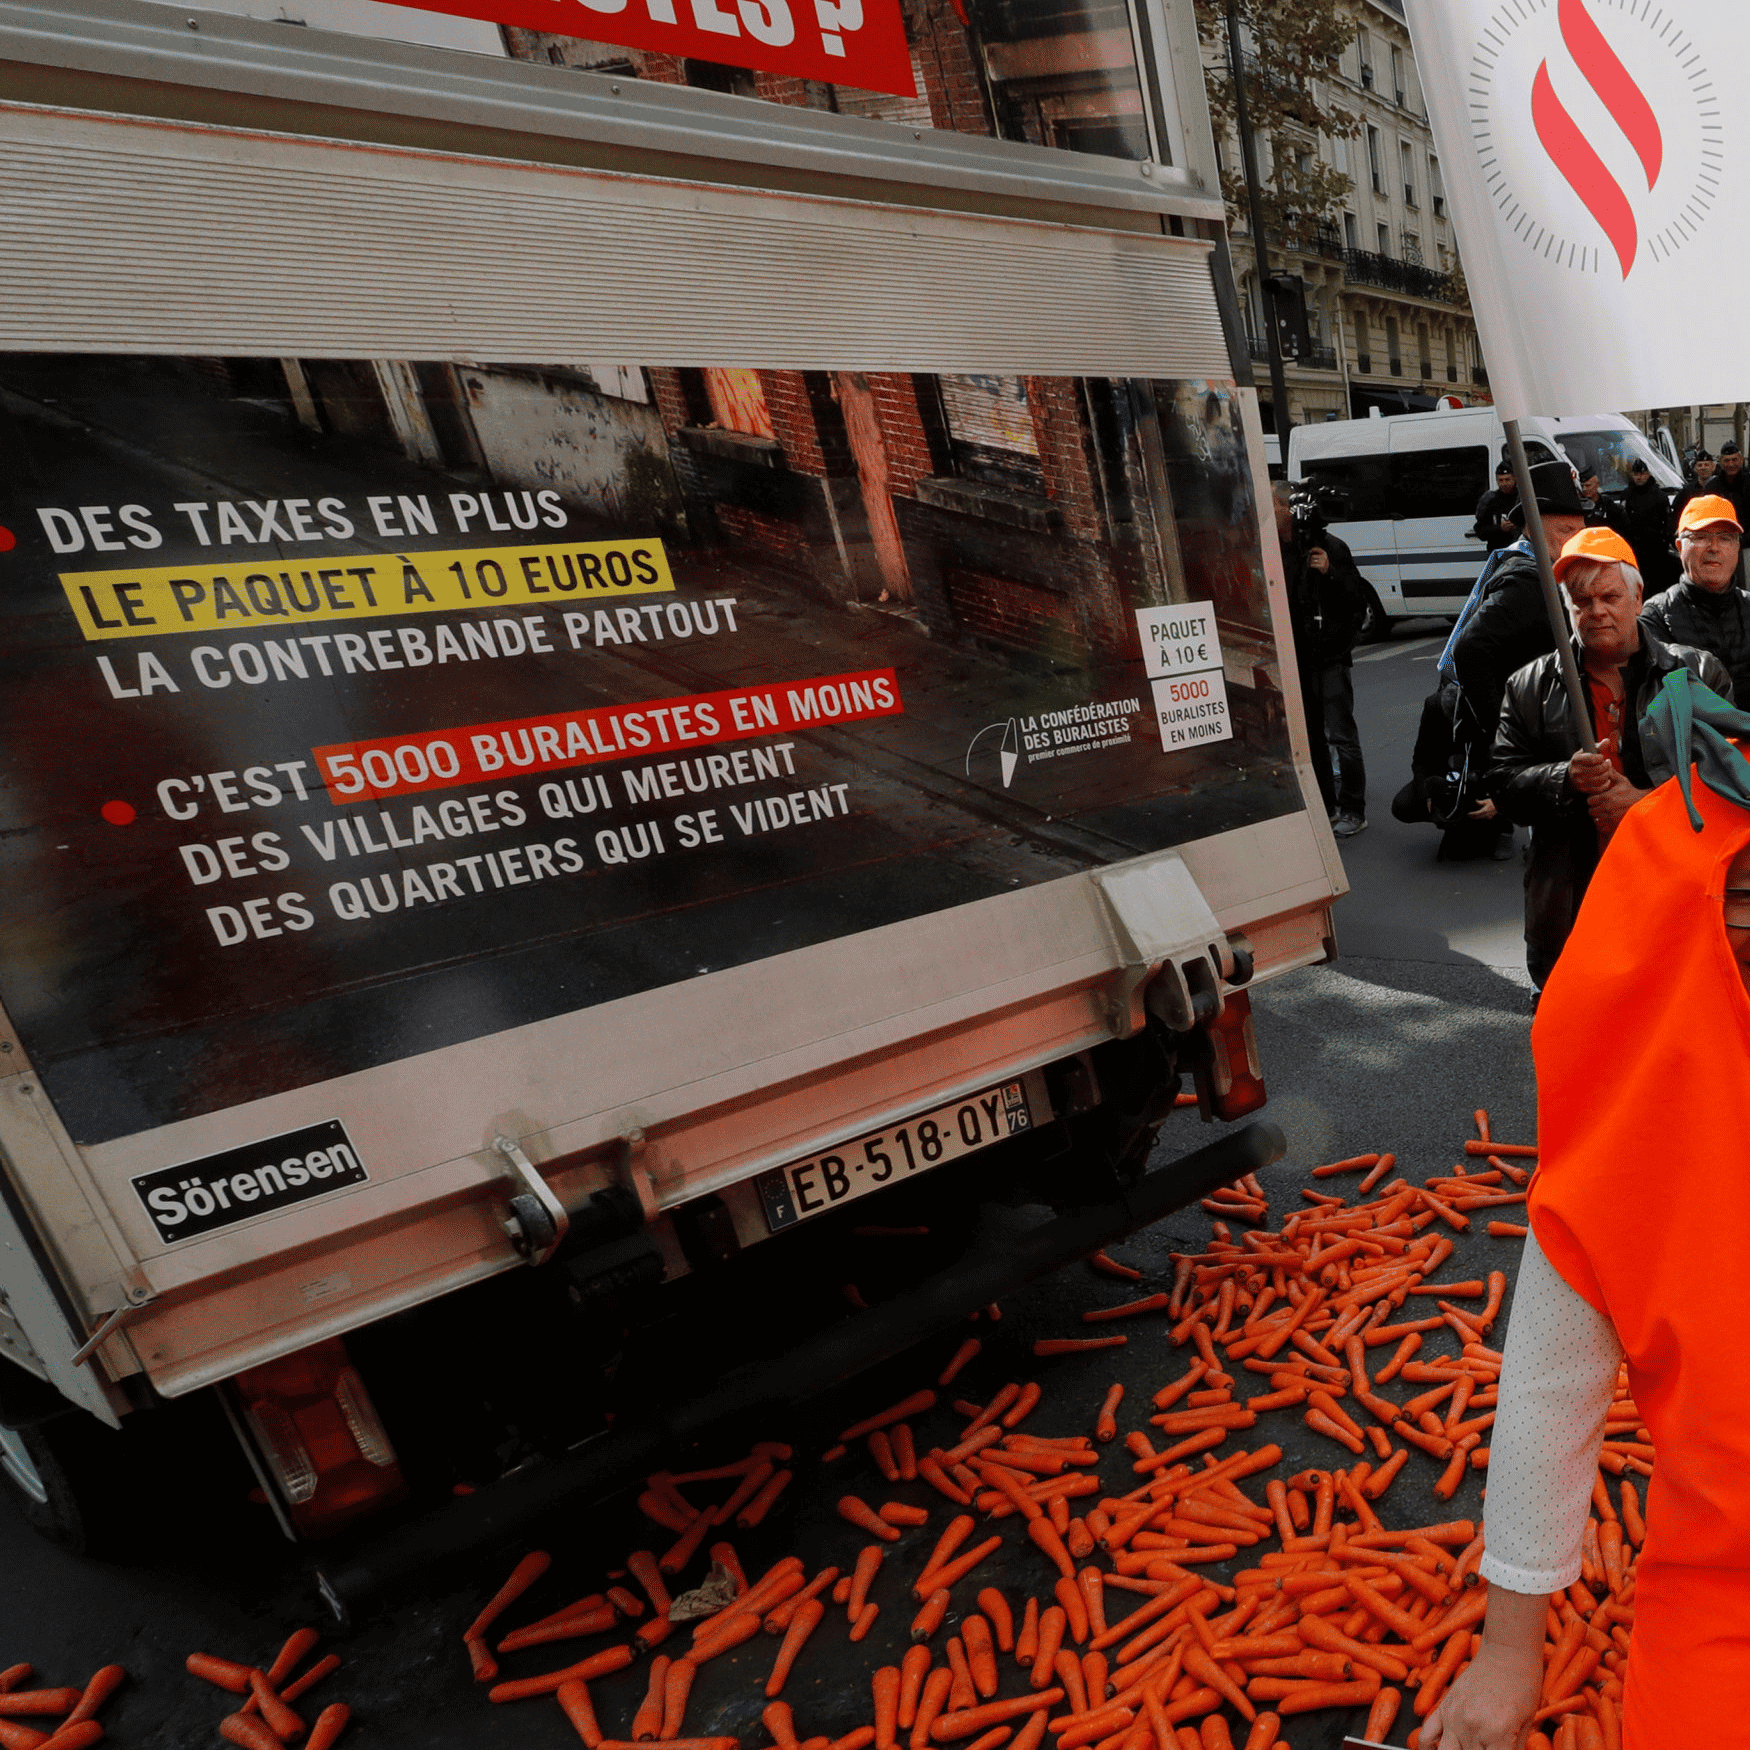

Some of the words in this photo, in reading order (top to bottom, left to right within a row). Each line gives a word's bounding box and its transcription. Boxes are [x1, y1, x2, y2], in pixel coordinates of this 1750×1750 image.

[36, 504, 163, 554] DES
[174, 497, 355, 546] TAXES
[366, 494, 438, 536] EN
[450, 490, 569, 533] PLUS
[79, 581, 157, 630] LE
[171, 566, 377, 622] PAQUET
[394, 555, 435, 605] À
[447, 559, 508, 600] 10
[519, 548, 661, 594] EUROS
[1150, 618, 1207, 642] PAQUET
[96, 650, 181, 700] LA
[189, 614, 556, 689] CONTREBANDE
[563, 597, 740, 651] PARTOUT
[1160, 644, 1171, 667] À
[1175, 645, 1194, 665] 10
[1169, 680, 1210, 702] 5000
[1020, 716, 1037, 733] LA
[1040, 698, 1141, 728] CONFÉDÉRATION
[1160, 701, 1226, 725] BURALISTES
[326, 740, 461, 795] 5000
[470, 702, 721, 773] BURALISTES
[729, 694, 781, 730] EN
[787, 676, 896, 723] MOINS
[1024, 732, 1050, 750] DES
[1053, 717, 1130, 745] BURALISTES
[1028, 748, 1055, 764] premier
[1056, 742, 1092, 757] commerce
[1092, 739, 1101, 750] de
[1101, 733, 1132, 750] proximité
[1170, 728, 1185, 743] EN
[1188, 722, 1223, 740] MOINS
[178, 831, 290, 886] DES
[299, 789, 528, 864] VILLAGES
[537, 775, 614, 820] QUI
[621, 743, 798, 805] MEURENT
[205, 890, 316, 947] DES
[328, 837, 585, 921] QUARTIERS
[595, 822, 666, 866] QUI
[674, 808, 724, 849] SE
[728, 783, 851, 837] VIDENT
[1007, 1109, 1028, 1131] 76
[791, 1095, 1000, 1212] EB-518-QY
[148, 1143, 358, 1225] Sörensen
[776, 1205, 785, 1219] F
